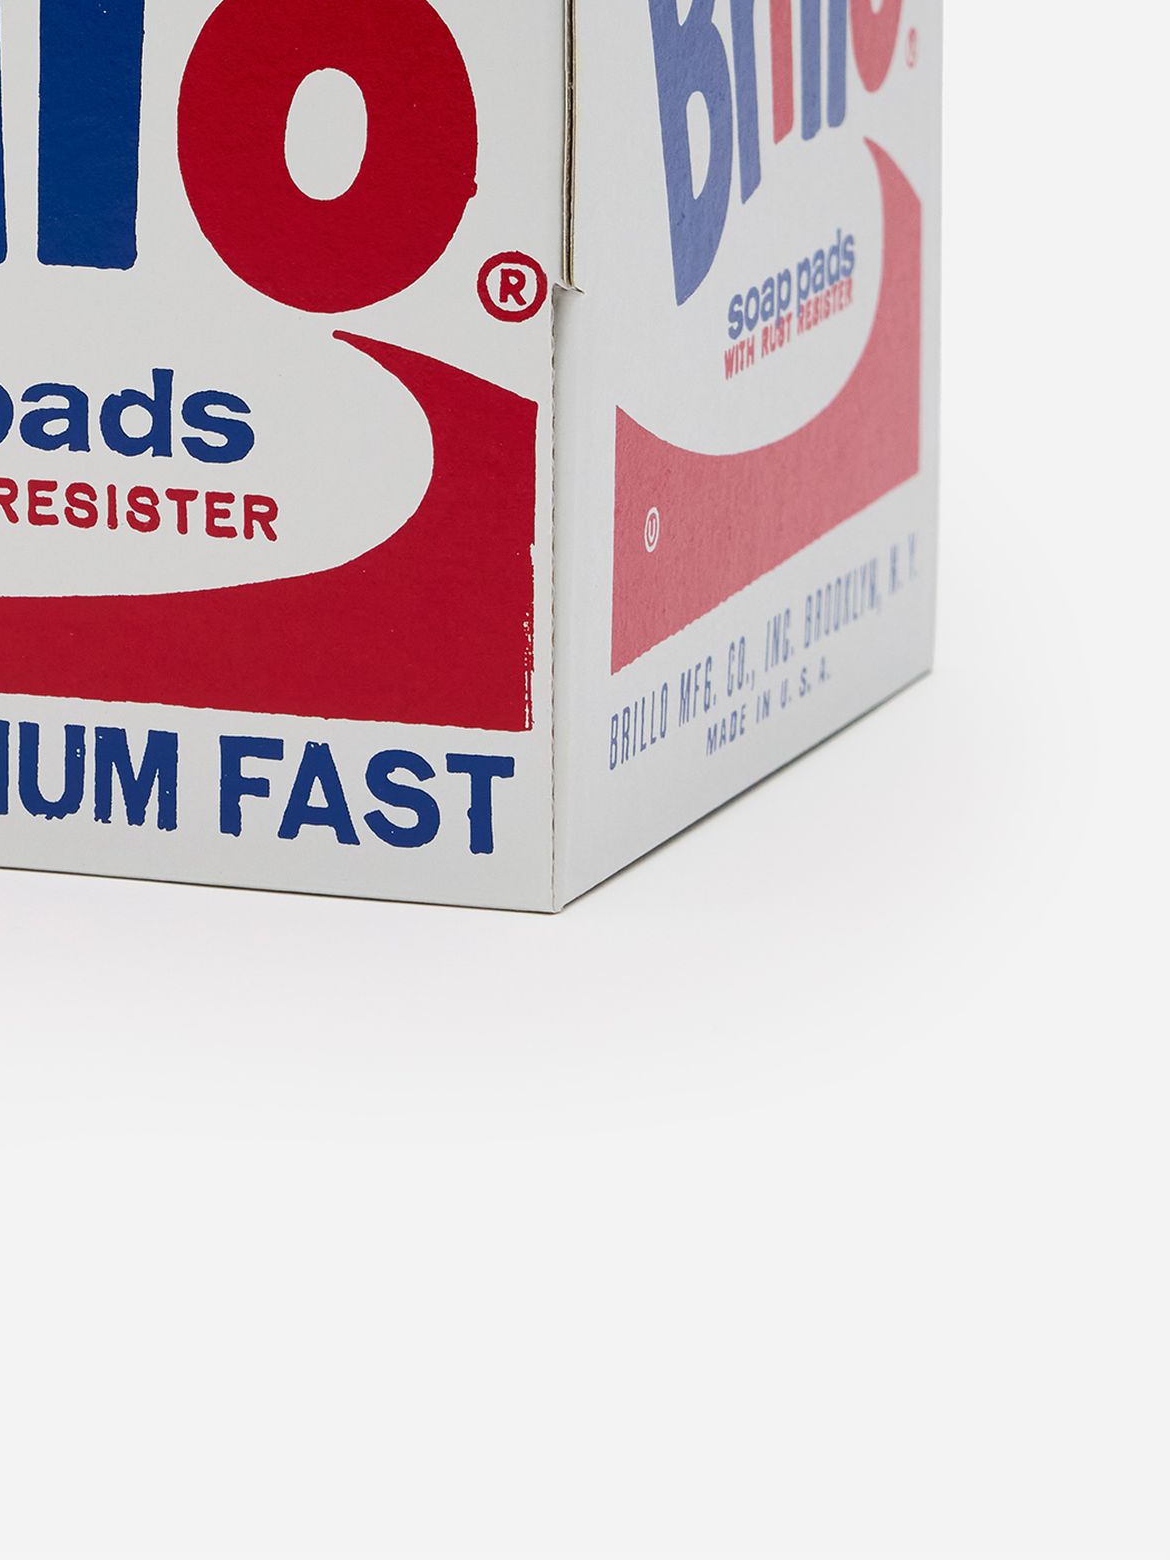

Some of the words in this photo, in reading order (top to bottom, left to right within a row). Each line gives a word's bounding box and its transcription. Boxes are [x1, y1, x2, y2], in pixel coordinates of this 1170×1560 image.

[723, 339, 756, 381] WITH
[761, 312, 793, 359] RUST
[796, 277, 854, 336] RESISTER
[727, 267, 793, 341] soap
[795, 227, 856, 321] pads
[608, 681, 669, 771] BRILLO
[677, 654, 717, 729] MFG.
[705, 703, 747, 757] MADE
[755, 689, 771, 725] IN
[218, 733, 516, 856] FAST
